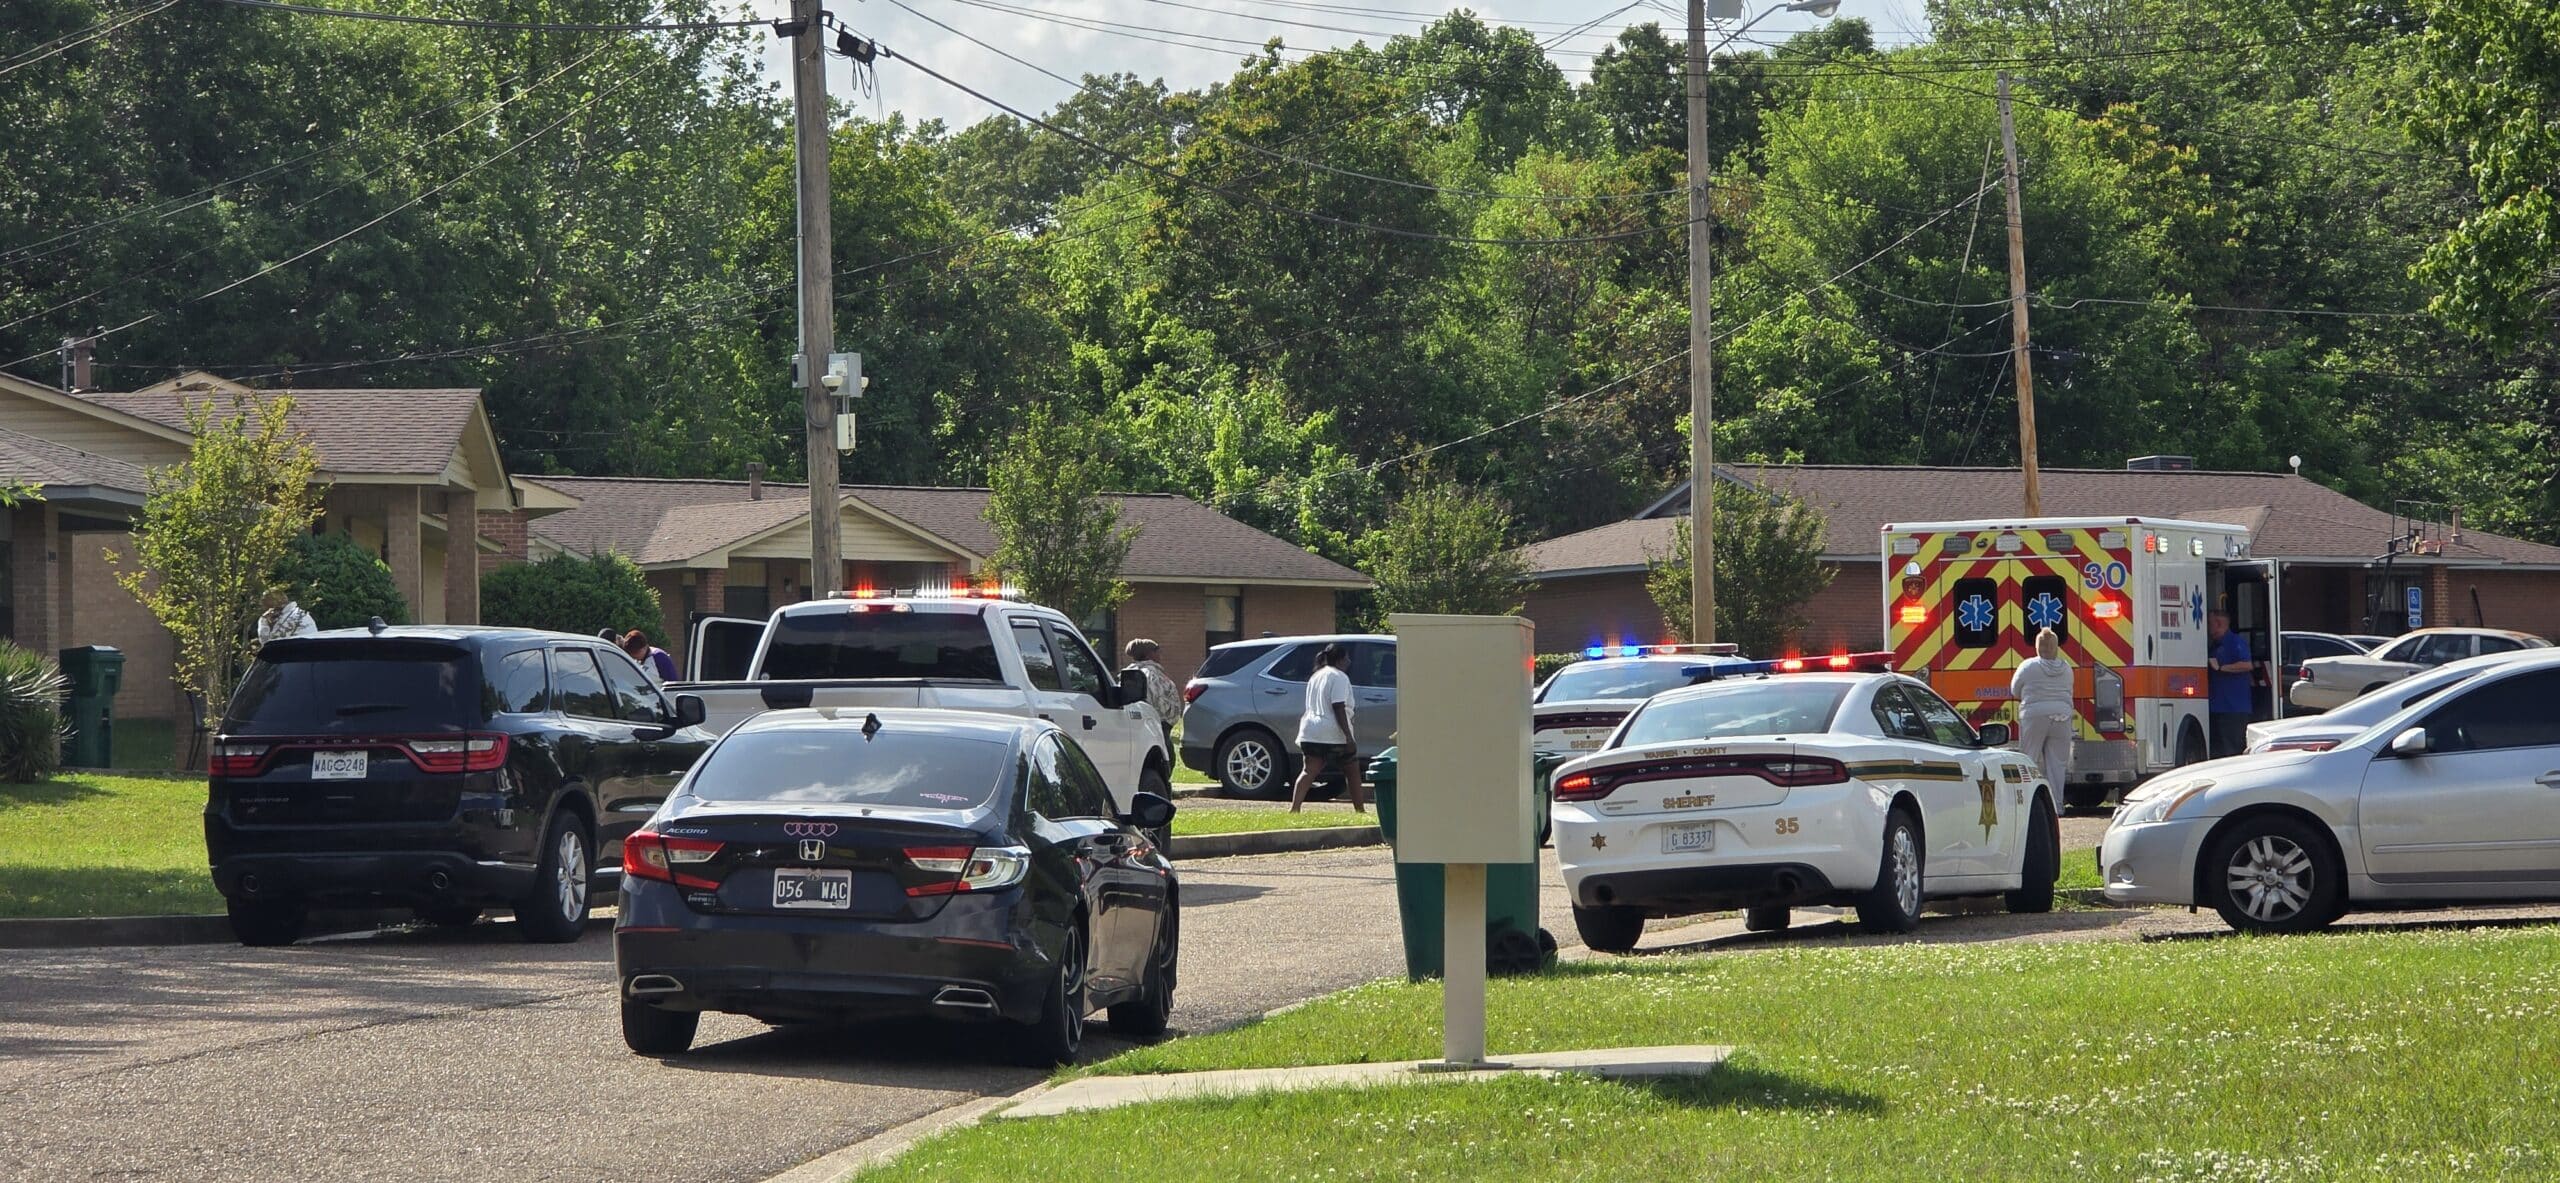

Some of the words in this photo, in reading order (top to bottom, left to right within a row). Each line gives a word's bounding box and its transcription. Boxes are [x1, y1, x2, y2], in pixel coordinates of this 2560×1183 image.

[2083, 561, 2127, 590] 30
[1643, 749, 1678, 759] WARREN
[1693, 746, 1728, 755] COUNTY
[345, 758, 365, 772] 248
[1662, 794, 1715, 809] SHERIFF
[1775, 816, 1800, 835] 35
[1671, 833, 1678, 846] G
[1682, 829, 1712, 846] 83337
[777, 880, 804, 899] 056
[821, 881, 848, 900] WAC
